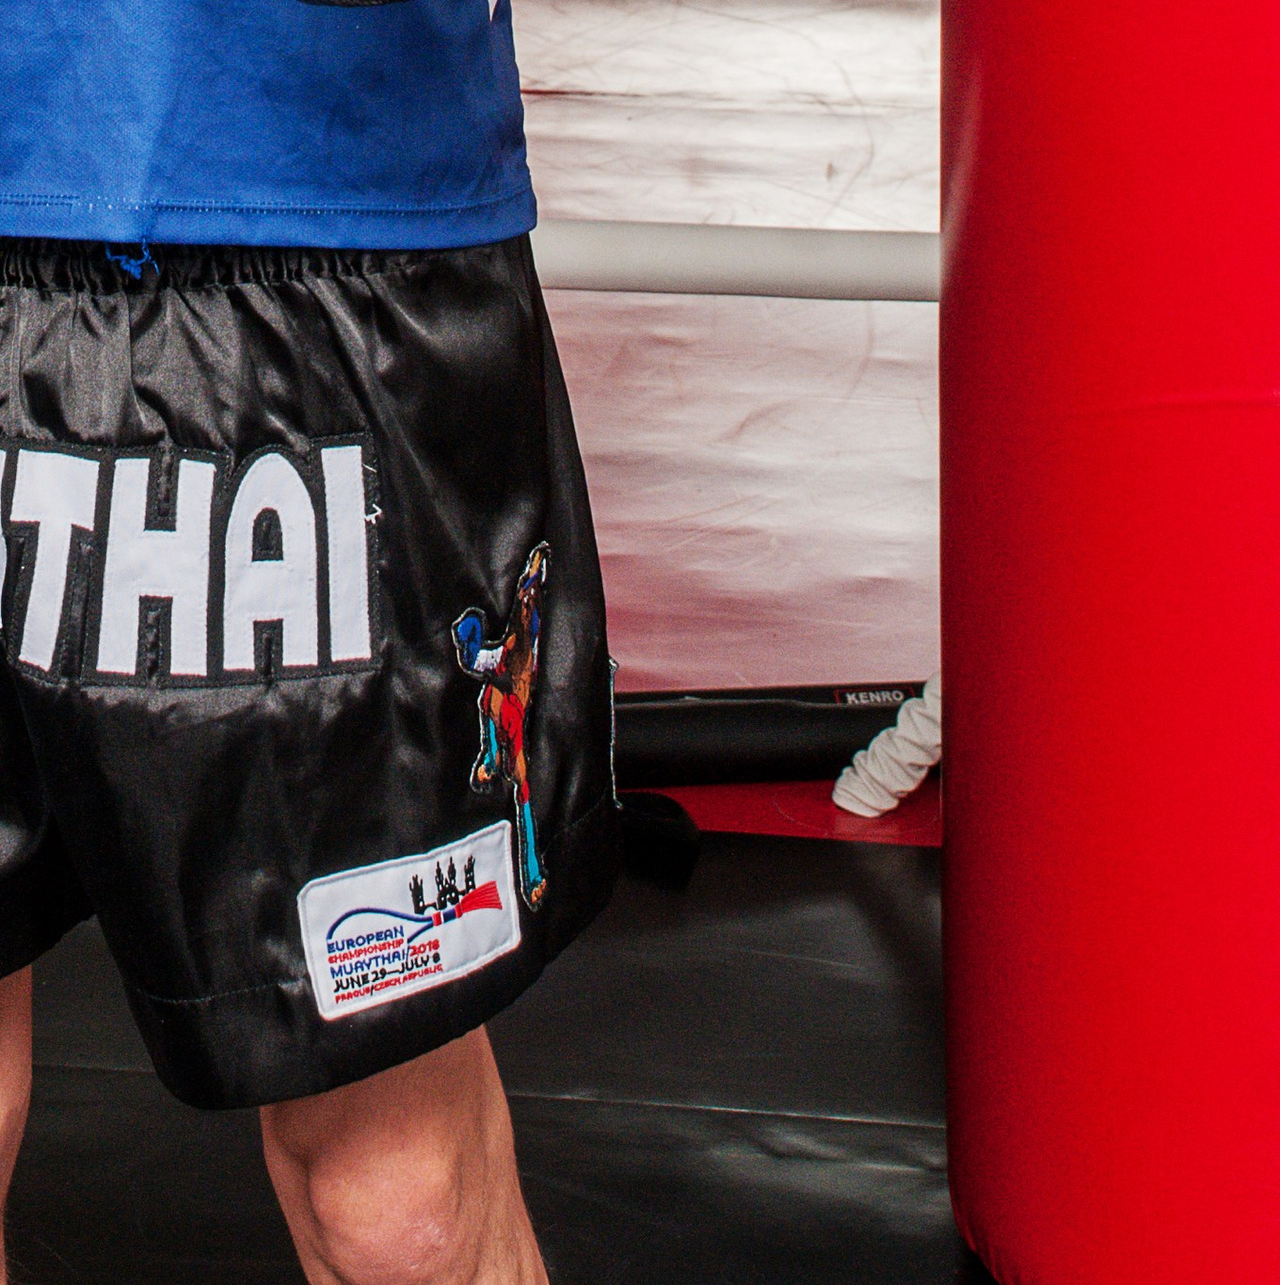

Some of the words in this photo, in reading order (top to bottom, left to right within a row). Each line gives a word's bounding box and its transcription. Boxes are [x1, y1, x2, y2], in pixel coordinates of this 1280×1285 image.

[845, 690, 905, 705] KENRO
[327, 925, 405, 954] EUROPEAN
[328, 938, 404, 964] CHAMPIONSHIP
[333, 973, 370, 993] JUNE
